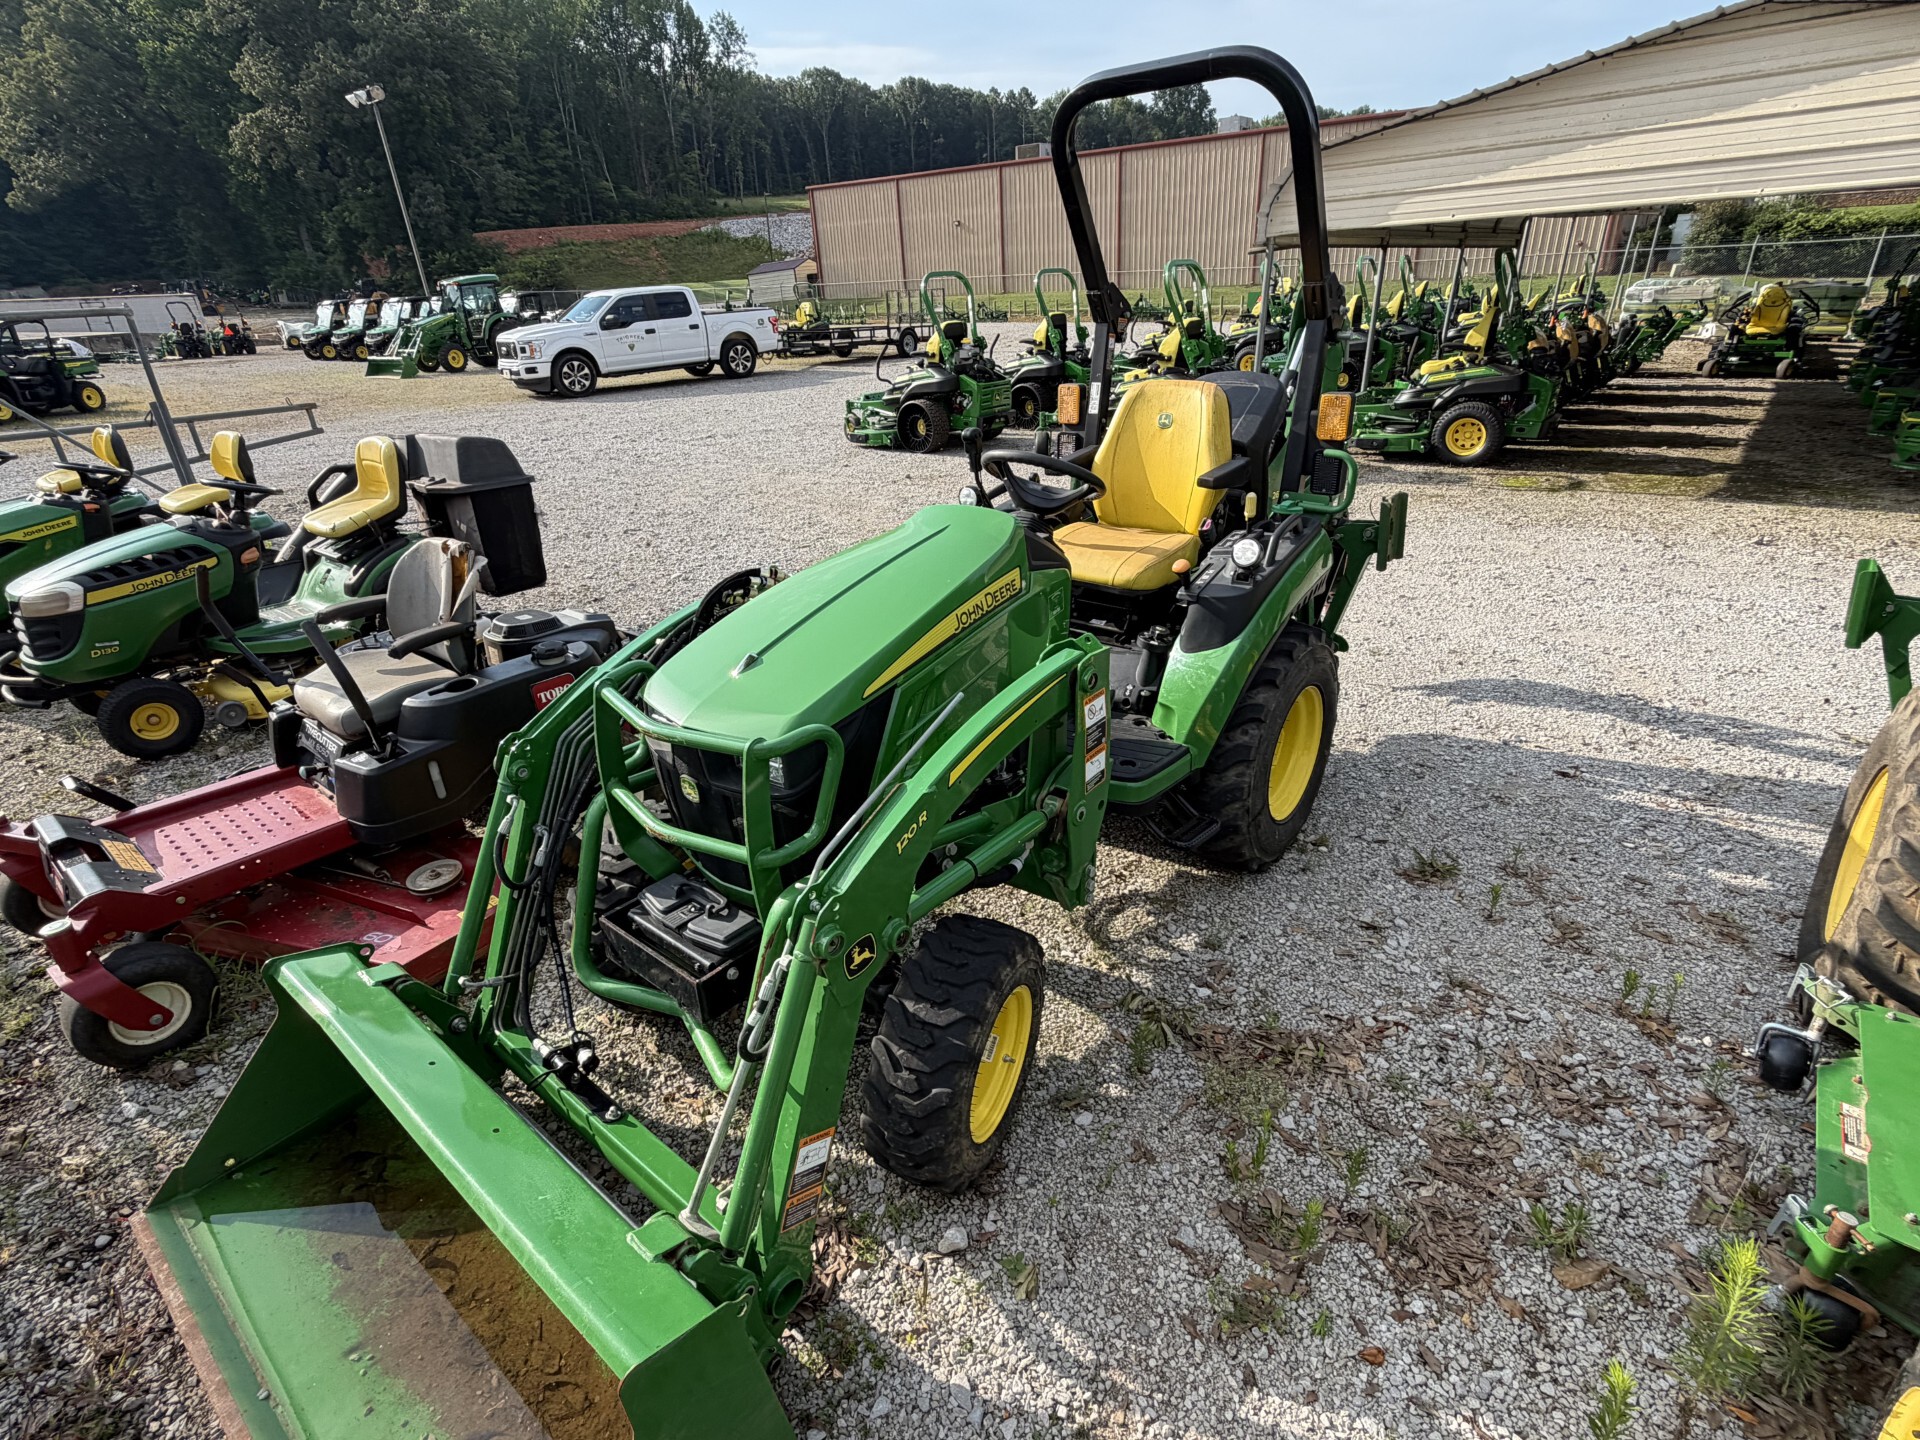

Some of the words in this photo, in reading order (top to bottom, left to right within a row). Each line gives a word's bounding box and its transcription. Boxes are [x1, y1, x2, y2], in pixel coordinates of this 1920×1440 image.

[22, 528, 44, 538] JOHN
[45, 520, 73, 531] DEERE
[130, 576, 164, 593] JOHN
[164, 567, 197, 583] DEER
[954, 600, 985, 632] JOHN
[984, 579, 1018, 609] DEERE
[90, 646, 120, 658] D130
[896, 823, 917, 855] 120
[918, 810, 928, 828] R
[363, 931, 393, 943] 60
